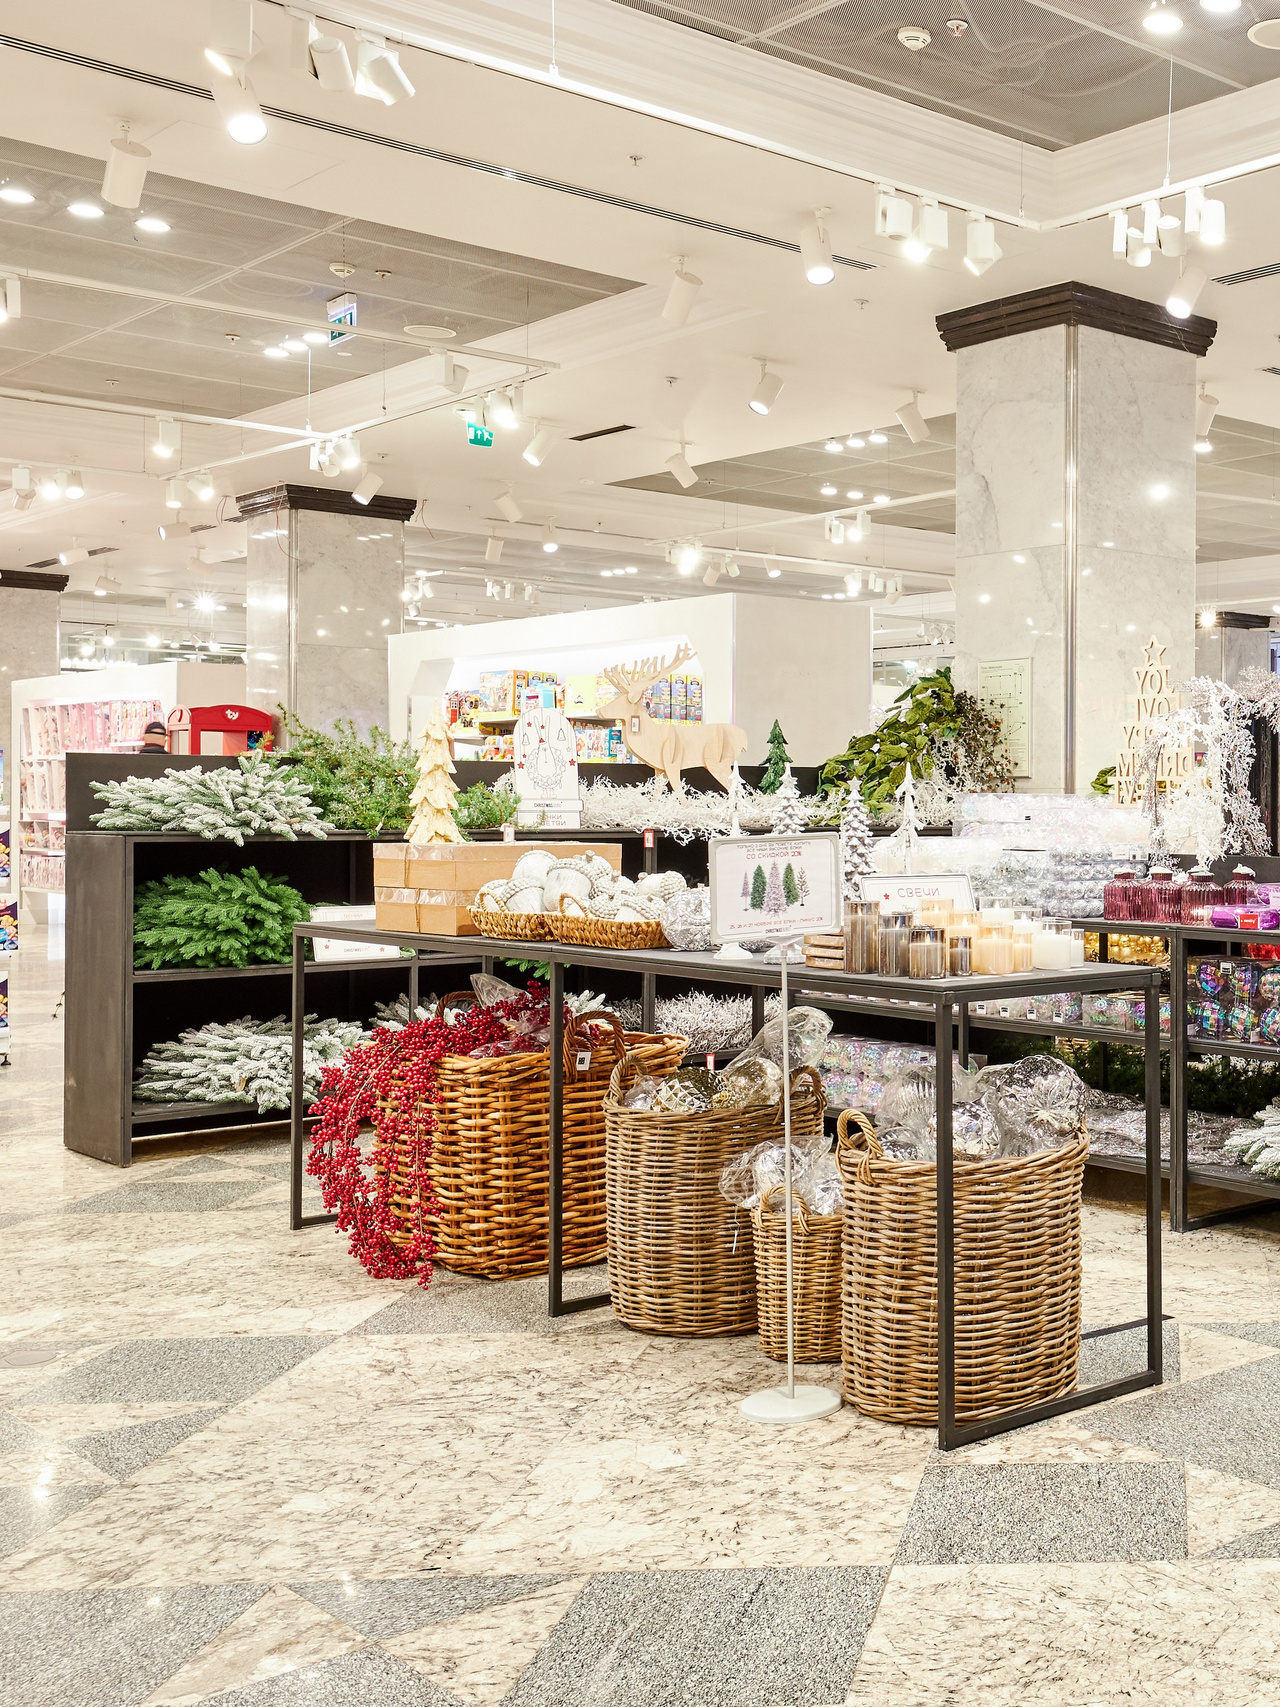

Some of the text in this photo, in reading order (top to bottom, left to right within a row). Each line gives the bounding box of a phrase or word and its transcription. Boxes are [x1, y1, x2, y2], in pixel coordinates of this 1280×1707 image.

[225, 709, 239, 720] ty
[758, 851, 789, 859] СКИДКОЙ
[897, 888, 940, 898] СВЕЧИ
